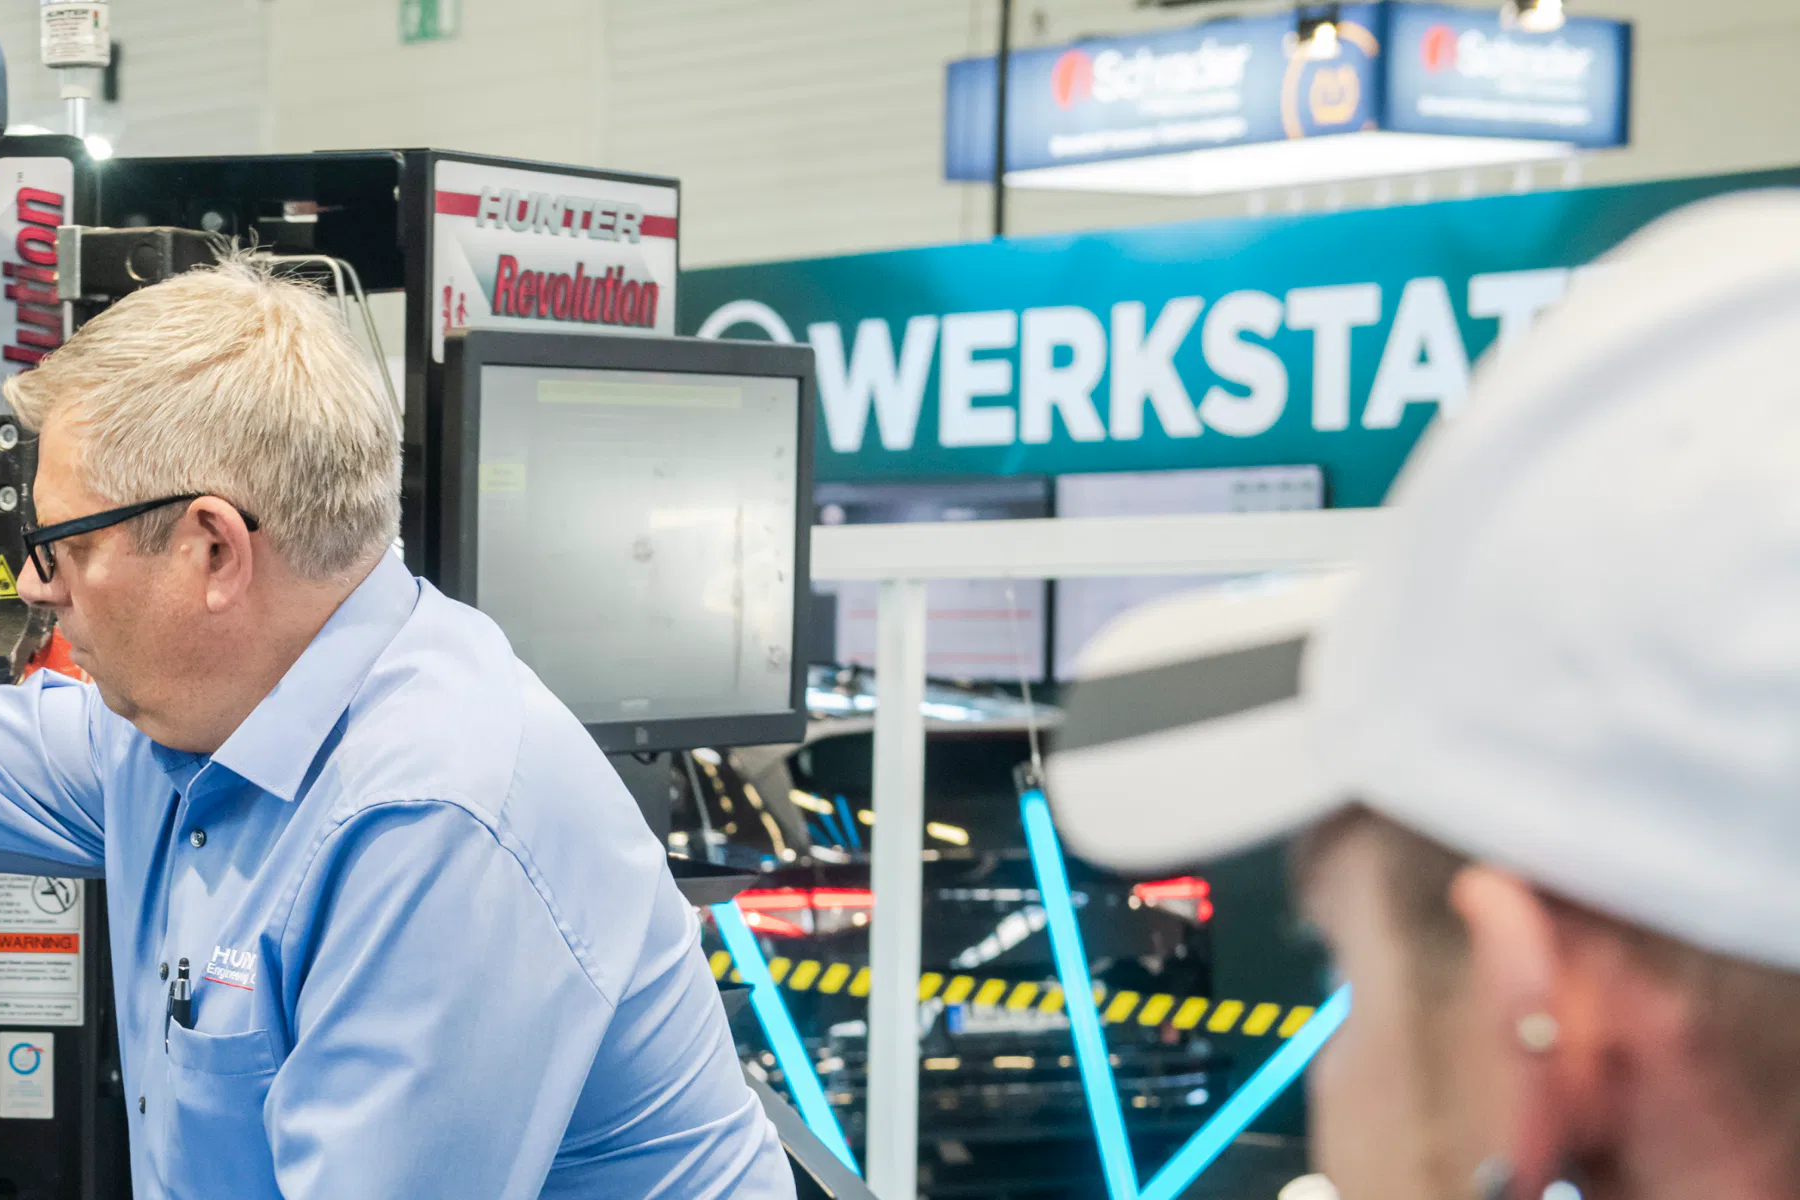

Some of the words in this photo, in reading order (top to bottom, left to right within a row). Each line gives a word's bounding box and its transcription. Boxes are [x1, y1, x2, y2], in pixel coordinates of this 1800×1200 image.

[476, 186, 644, 244] HUNTER
[3, 187, 65, 378] lution
[491, 253, 660, 329] Revolution
[806, 265, 1608, 454] WERKSTAT
